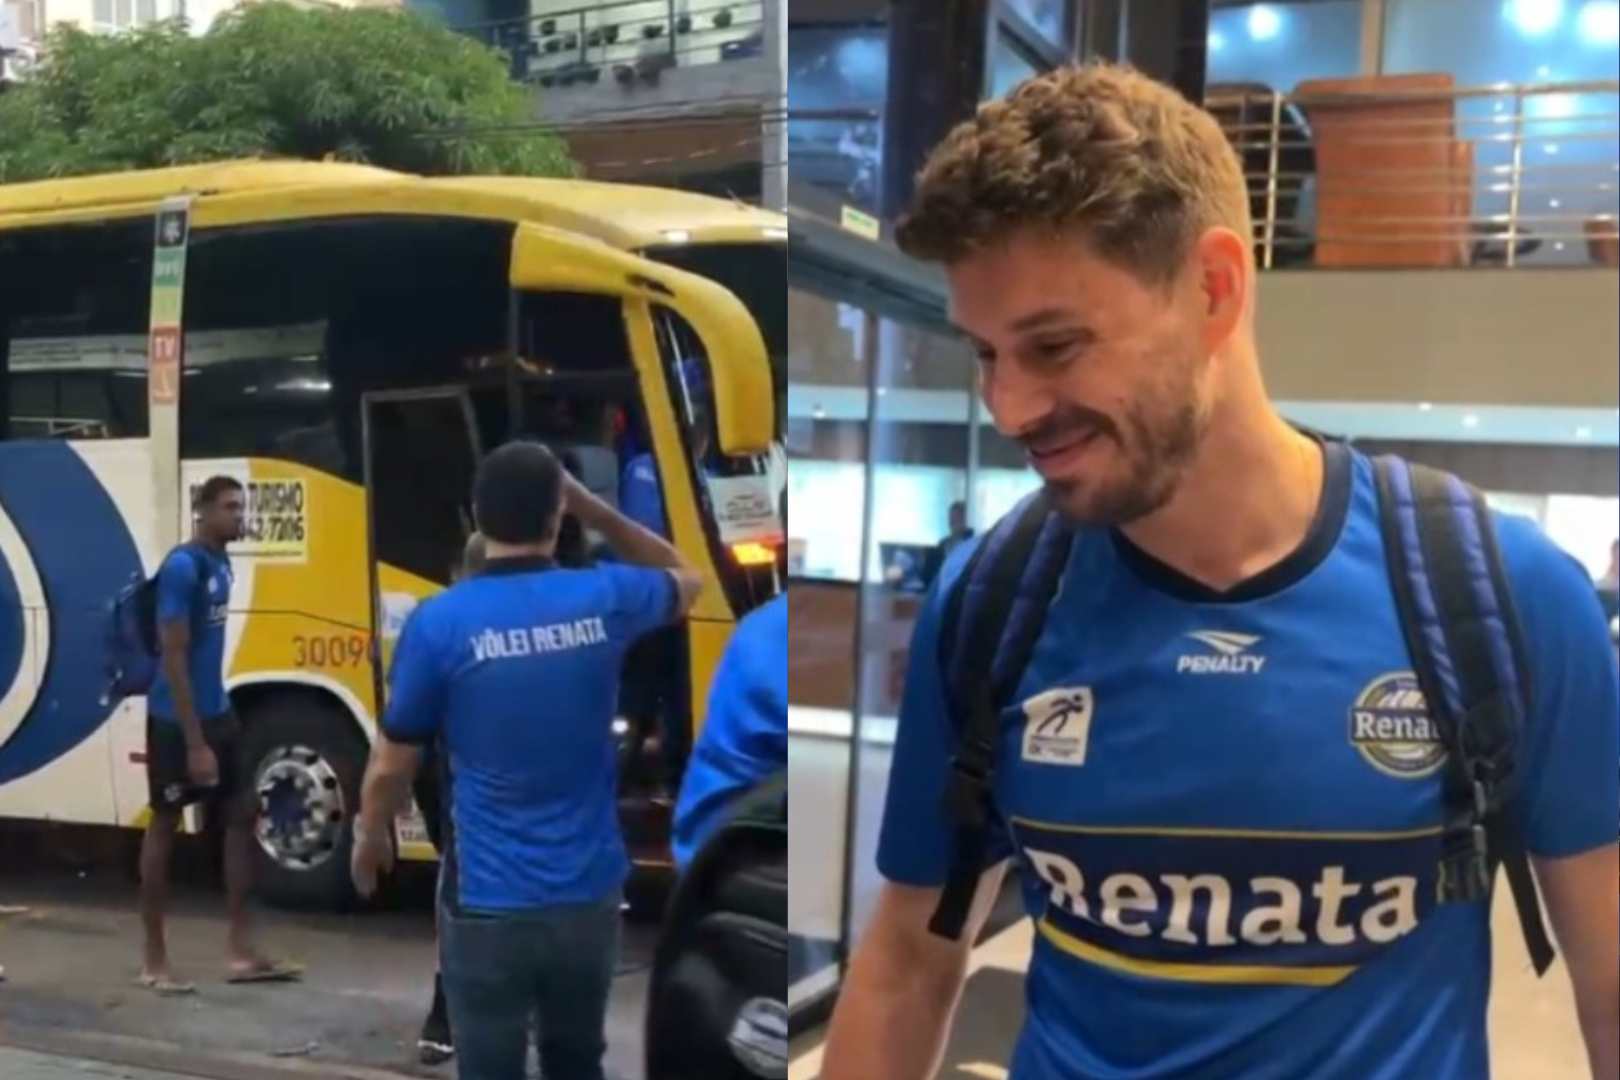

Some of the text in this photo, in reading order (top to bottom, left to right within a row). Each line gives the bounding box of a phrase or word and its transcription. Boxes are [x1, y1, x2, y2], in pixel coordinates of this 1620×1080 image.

[154, 336, 176, 358] TV
[248, 482, 304, 513] TURISMO
[470, 616, 607, 662] VÔLEI RENATA
[1176, 655, 1266, 673] PENALTY
[1023, 846, 1418, 946] Renata
